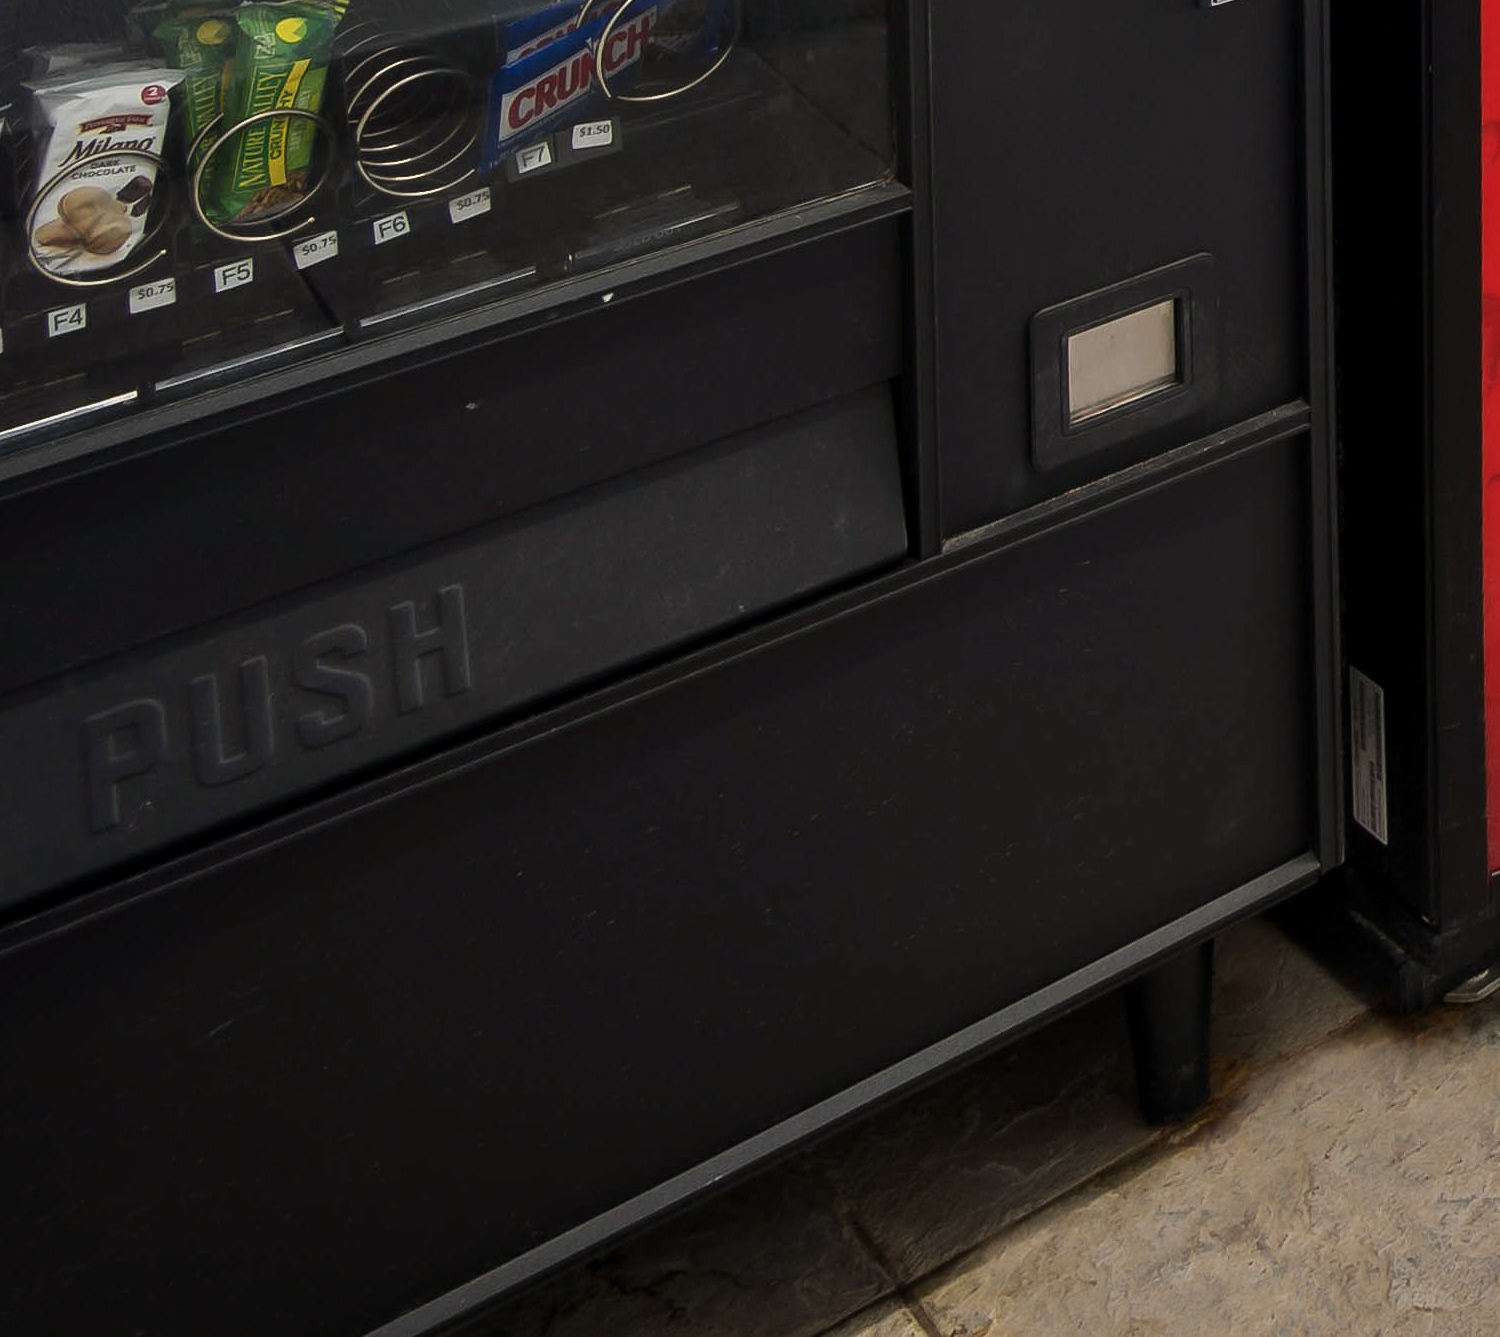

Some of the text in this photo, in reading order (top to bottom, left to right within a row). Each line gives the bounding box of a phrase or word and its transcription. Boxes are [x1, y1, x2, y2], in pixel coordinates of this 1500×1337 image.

[507, 15, 652, 129] CRUNCH
[578, 123, 610, 138] $1.50
[59, 136, 155, 167] Milano
[523, 148, 546, 169] F7
[72, 165, 136, 180] CHOCOLATE
[457, 191, 490, 209] $0.75
[378, 216, 406, 239] F6
[302, 236, 337, 256] $0.75
[221, 264, 251, 286] F5
[137, 283, 174, 300] $0.75
[53, 309, 82, 331] F4
[87, 582, 472, 836] PUSH
